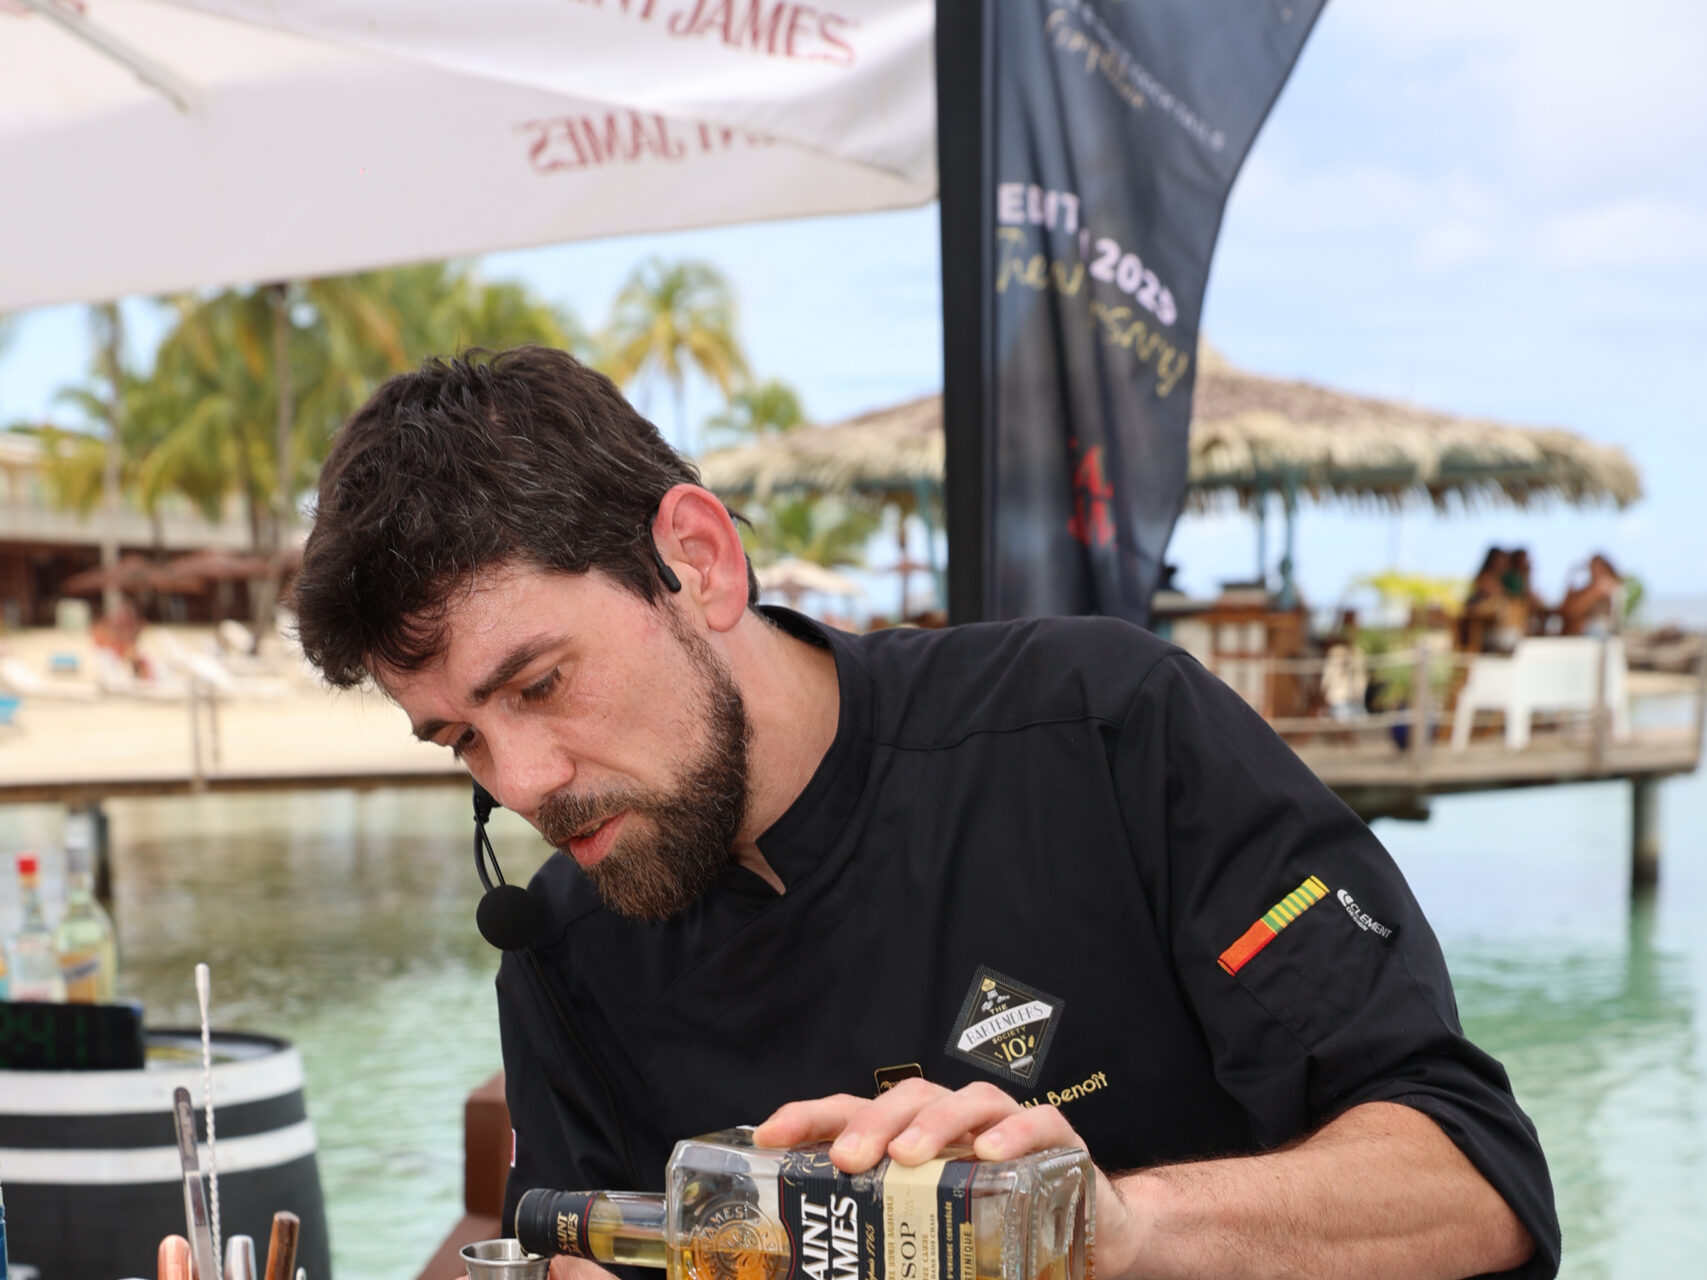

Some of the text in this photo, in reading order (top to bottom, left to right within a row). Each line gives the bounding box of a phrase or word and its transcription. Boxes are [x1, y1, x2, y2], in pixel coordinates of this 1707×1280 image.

[667, 0, 858, 66] JAMES
[1090, 238, 1178, 326] 2025
[1350, 903, 1393, 938] CLEMENT
[965, 1003, 1044, 1045] BARTENDERS
[990, 1003, 1008, 1015] THE
[992, 1025, 1026, 1045] SOCIETY
[1046, 1071, 1108, 1107] Benoît
[886, 1196, 895, 1239] AGRICOLE
[865, 1221, 876, 1257] 1765
